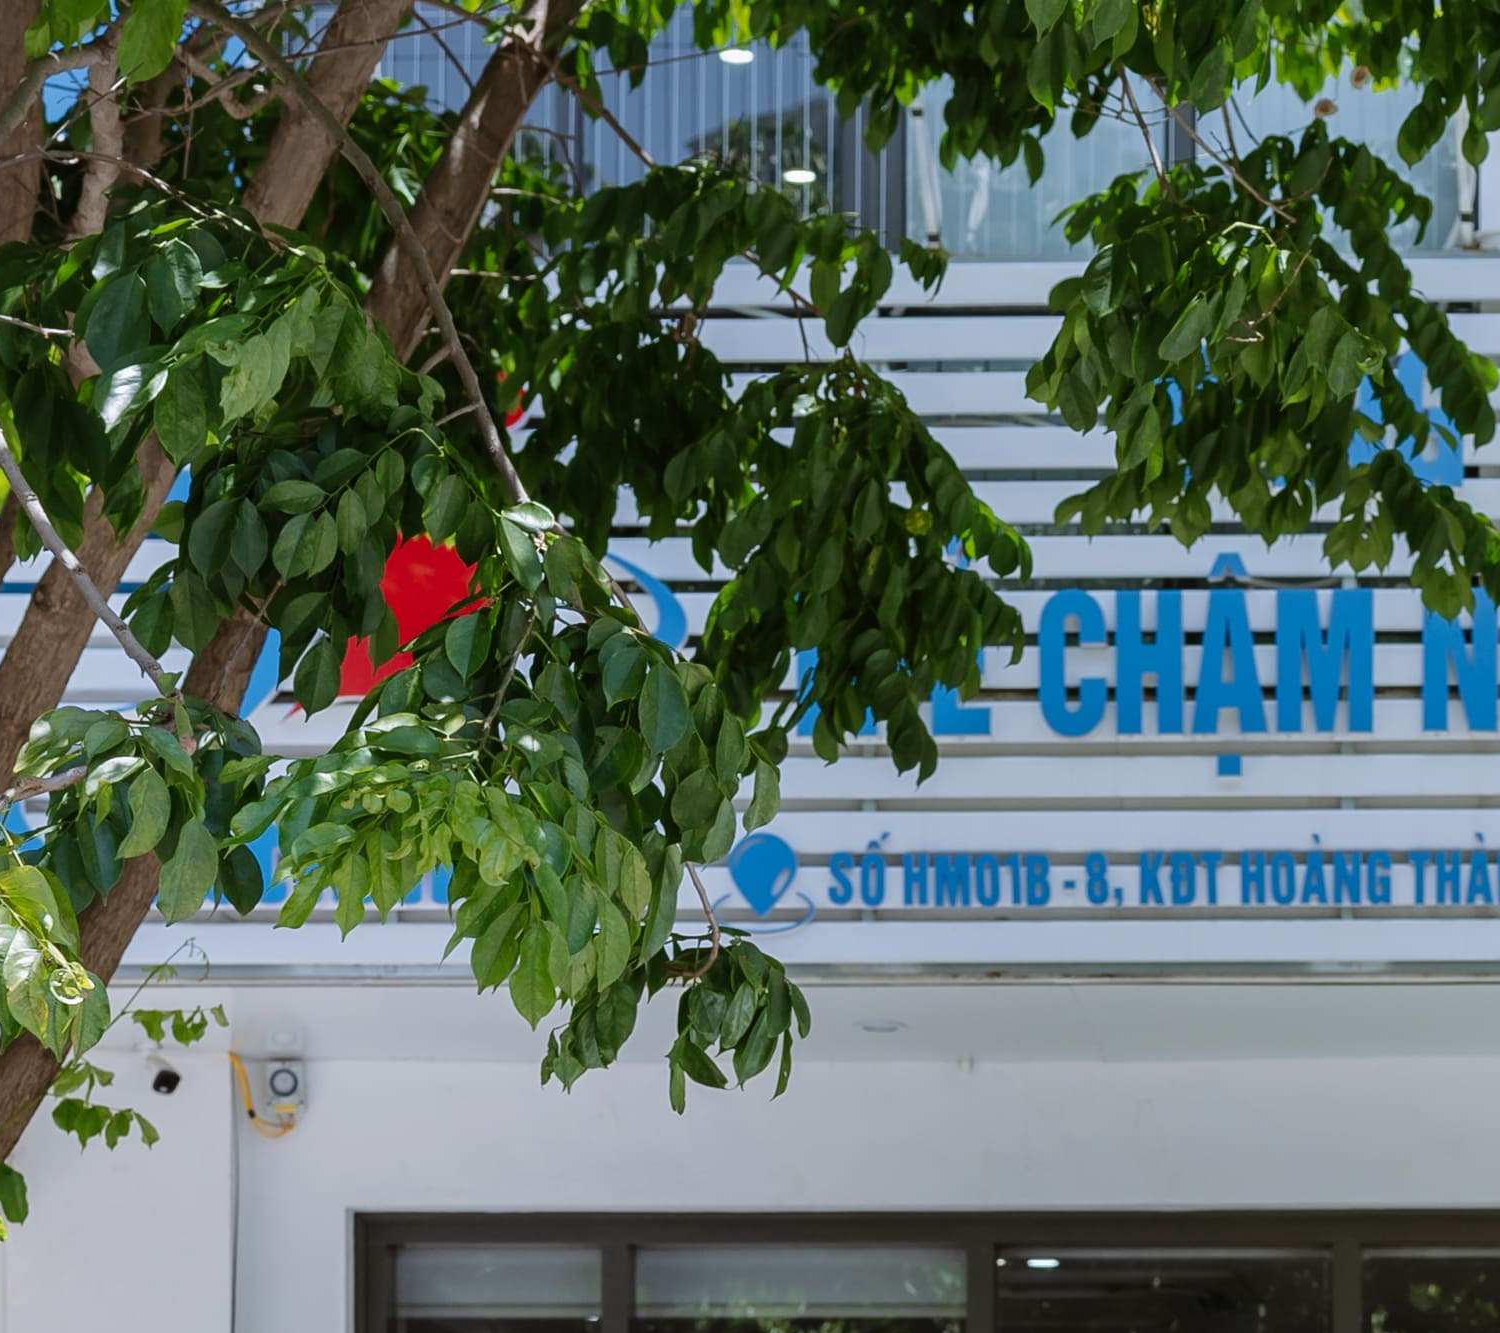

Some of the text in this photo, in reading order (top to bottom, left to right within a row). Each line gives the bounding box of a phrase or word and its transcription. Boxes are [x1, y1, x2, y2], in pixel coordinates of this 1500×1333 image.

[1037, 551, 1375, 776] CHẬM
[827, 832, 886, 908] SỐ
[1138, 849, 1225, 906] KĐT
[1239, 832, 1393, 906] HOÀNG
